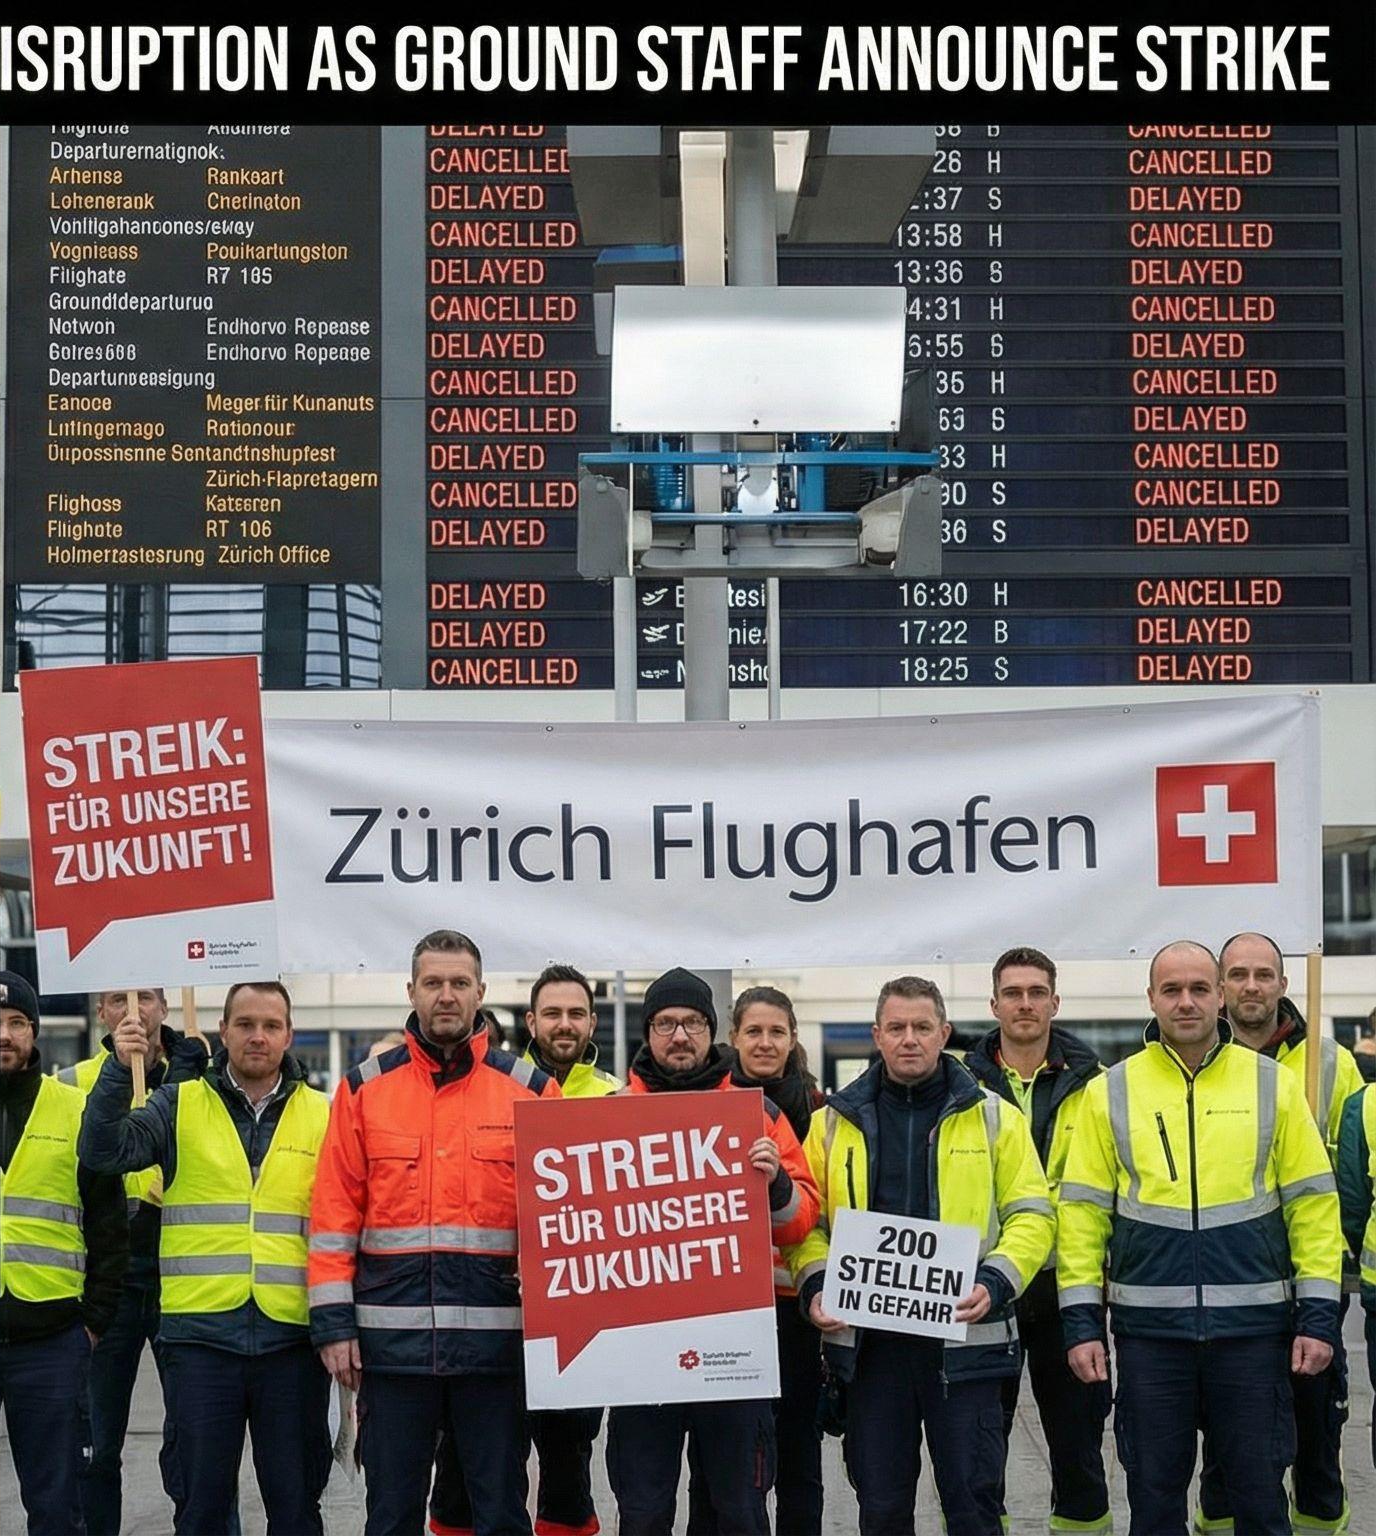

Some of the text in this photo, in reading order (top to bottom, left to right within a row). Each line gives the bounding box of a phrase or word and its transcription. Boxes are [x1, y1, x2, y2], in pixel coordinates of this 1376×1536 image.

[988, 151, 1000, 173] H
[1130, 150, 1271, 174] CANCELLED
[431, 185, 1240, 211] DELAYED :37 S DELAYED
[431, 222, 1272, 247] CANCELLED 13:58 H CANCELLED
[432, 259, 1242, 284] DELAYED 13:36 DELAYED
[431, 296, 1274, 321] CANCELLED 4:31 H CANCELLED
[432, 333, 1244, 358] DELAYED 6:55 DELAYED
[431, 370, 576, 395] CANCELLED
[992, 371, 1004, 394] H
[1133, 369, 1276, 394] CANCELLED
[431, 408, 576, 432] CANCELLED
[1135, 407, 1246, 431] DELAYED
[432, 445, 544, 470] DELAYED
[992, 445, 1005, 468] H
[1135, 443, 1278, 468] CANCELLED
[431, 482, 576, 507] CANCELLED
[992, 482, 1005, 505] S
[1135, 480, 1279, 505] CANCELLED
[207, 520, 271, 537] RT 106
[432, 520, 544, 545] DELAYED
[993, 520, 1006, 542] S
[1137, 518, 1248, 543] DELAYED
[219, 545, 273, 563] Zürich
[279, 545, 330, 563] Office
[432, 580, 1281, 609] DELAYED 16:30 H CANCELLED
[432, 618, 1250, 647] DELAYED 17:22 B DELAYED
[431, 655, 1251, 684] CANCELLED 18:25 S DELAYED
[43, 717, 247, 792] STREIK:
[48, 779, 250, 834] FÜR UNSERE
[49, 819, 251, 885] ZUKUNFT!
[325, 796, 1096, 902] Zürich Flughafen
[534, 1125, 746, 1205] STREIK:
[539, 1189, 749, 1248] FÜR UNSERE
[877, 1226, 937, 1259] 200
[544, 1231, 740, 1298] ZUKUNFT!
[838, 1251, 963, 1301] STELLEN
[839, 1289, 952, 1324] IN GEFAHR
